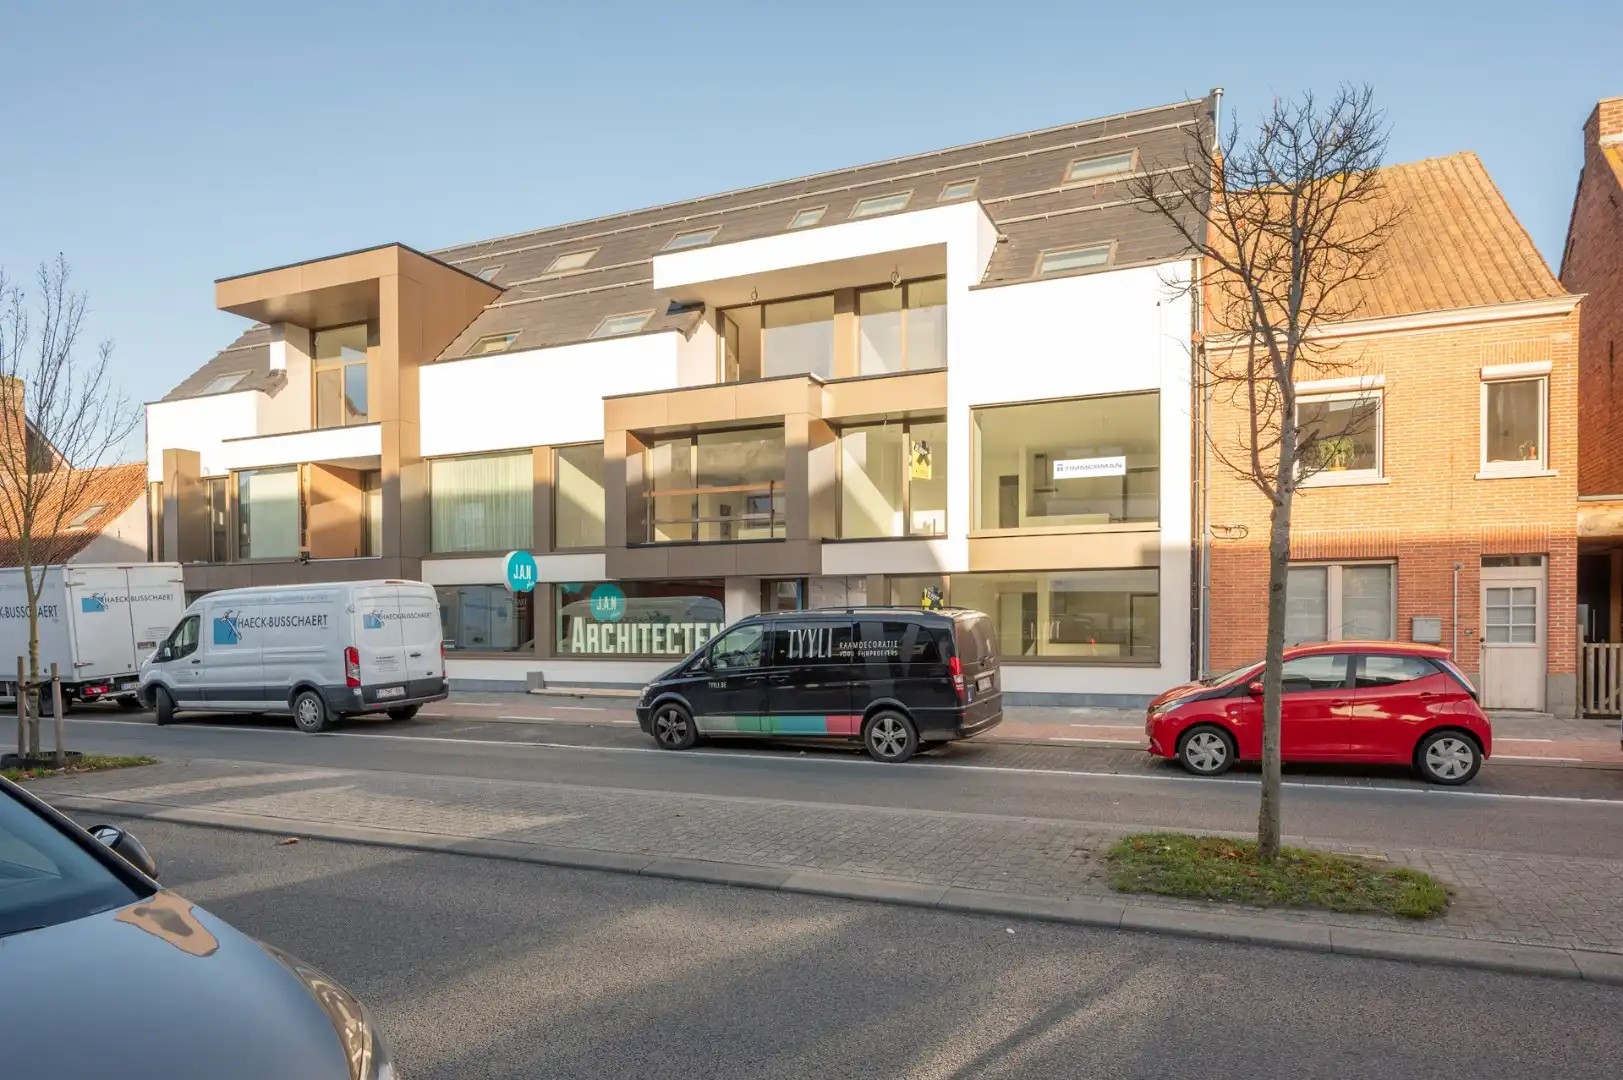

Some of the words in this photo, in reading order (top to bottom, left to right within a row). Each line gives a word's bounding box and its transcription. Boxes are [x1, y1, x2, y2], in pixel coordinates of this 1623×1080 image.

[1065, 463, 1122, 472] TIMMERMAN
[104, 594, 174, 604] HAECKBUSSCHAERT
[0, 604, 57, 618] K-BUSSCAERT
[383, 612, 432, 620] HAECKBUSSCHAERT
[238, 614, 328, 629] HAECK-BUSSCHAERT
[788, 628, 832, 658] TYYLI
